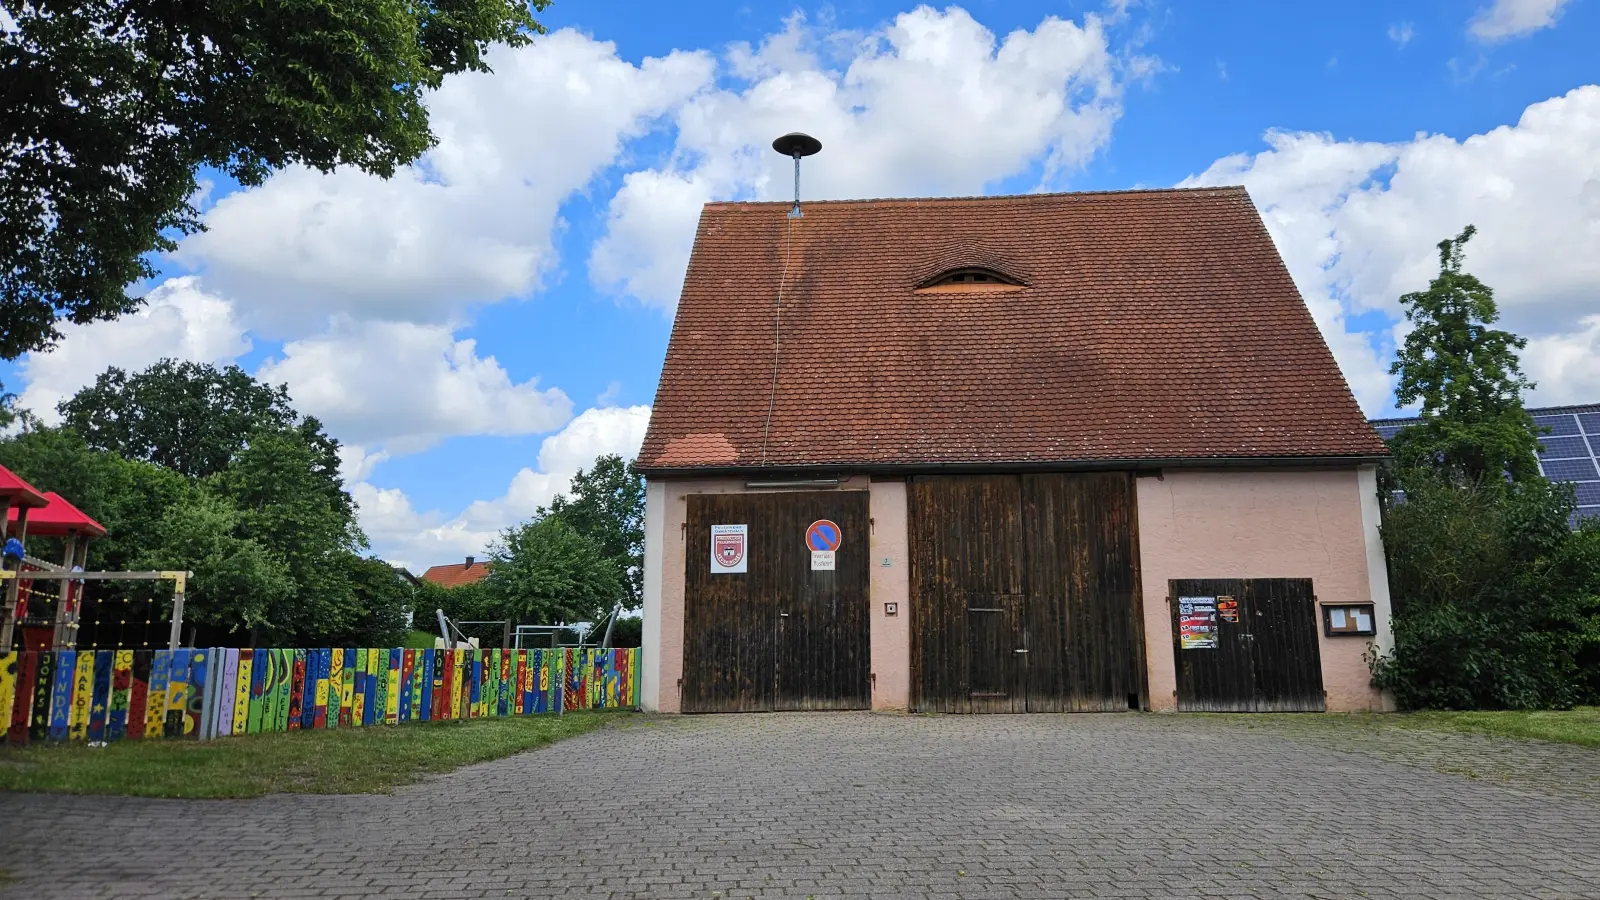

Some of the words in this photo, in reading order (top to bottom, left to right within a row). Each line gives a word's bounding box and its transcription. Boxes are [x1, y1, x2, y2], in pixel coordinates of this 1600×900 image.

[37, 655, 51, 708] JONAS
[54, 656, 70, 721] LINDA
[491, 662, 499, 698] ELLY
[278, 697, 286, 731] FELIX
